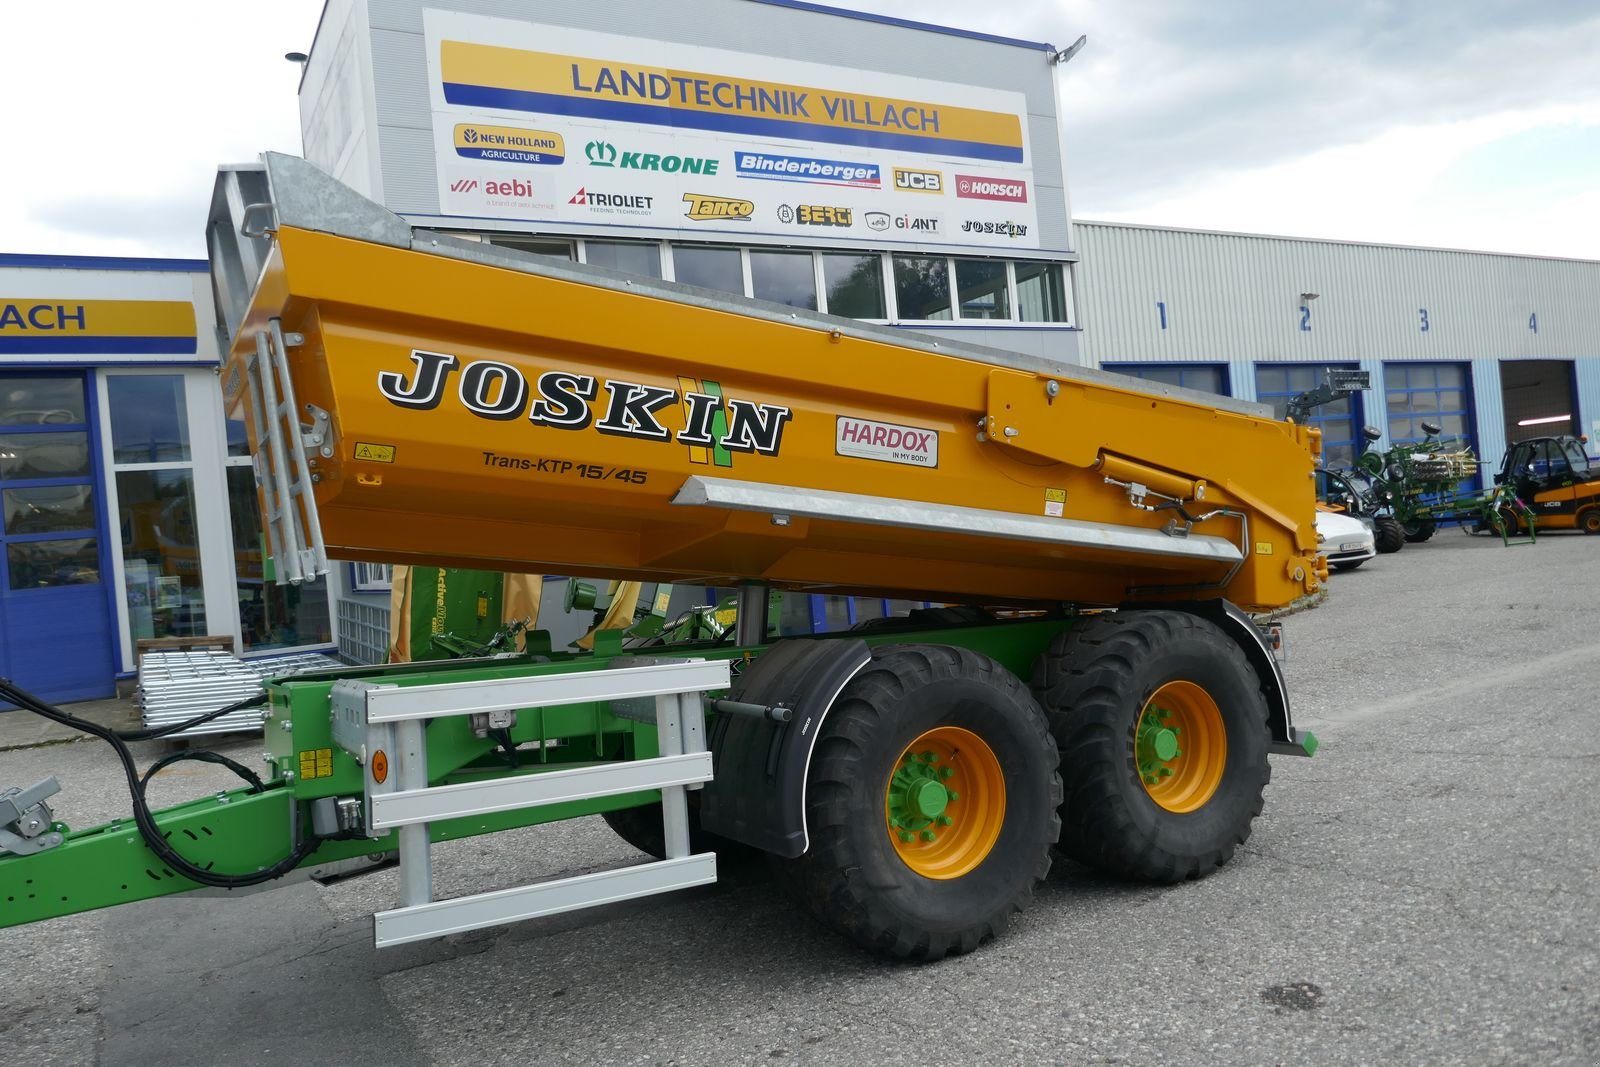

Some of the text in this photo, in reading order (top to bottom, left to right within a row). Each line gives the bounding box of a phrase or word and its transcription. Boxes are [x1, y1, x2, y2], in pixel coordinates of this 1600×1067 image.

[571, 64, 940, 133] LANDTECHNIK VILLACH
[481, 134, 556, 149] NEW HOLLAND
[481, 150, 540, 162] AGRICULTURE
[620, 152, 719, 176] KRONE
[740, 155, 877, 180] Binderberger
[485, 179, 532, 197] aebi
[896, 172, 940, 190] JCB
[972, 182, 1022, 197] HORSCH
[586, 193, 653, 209] TRIOLIET
[683, 193, 755, 218] Tanco
[961, 220, 1028, 237] JOSKIN
[0, 304, 86, 330] ACH
[1156, 302, 1167, 330] 1
[1299, 306, 1311, 331] 2
[1419, 308, 1429, 332] 3
[1528, 312, 1537, 334] 4
[377, 348, 793, 457] JOSKIN
[842, 421, 931, 453] HARDOX
[482, 452, 648, 485] Trans-KTP 15/45
[911, 454, 928, 462] BODY
